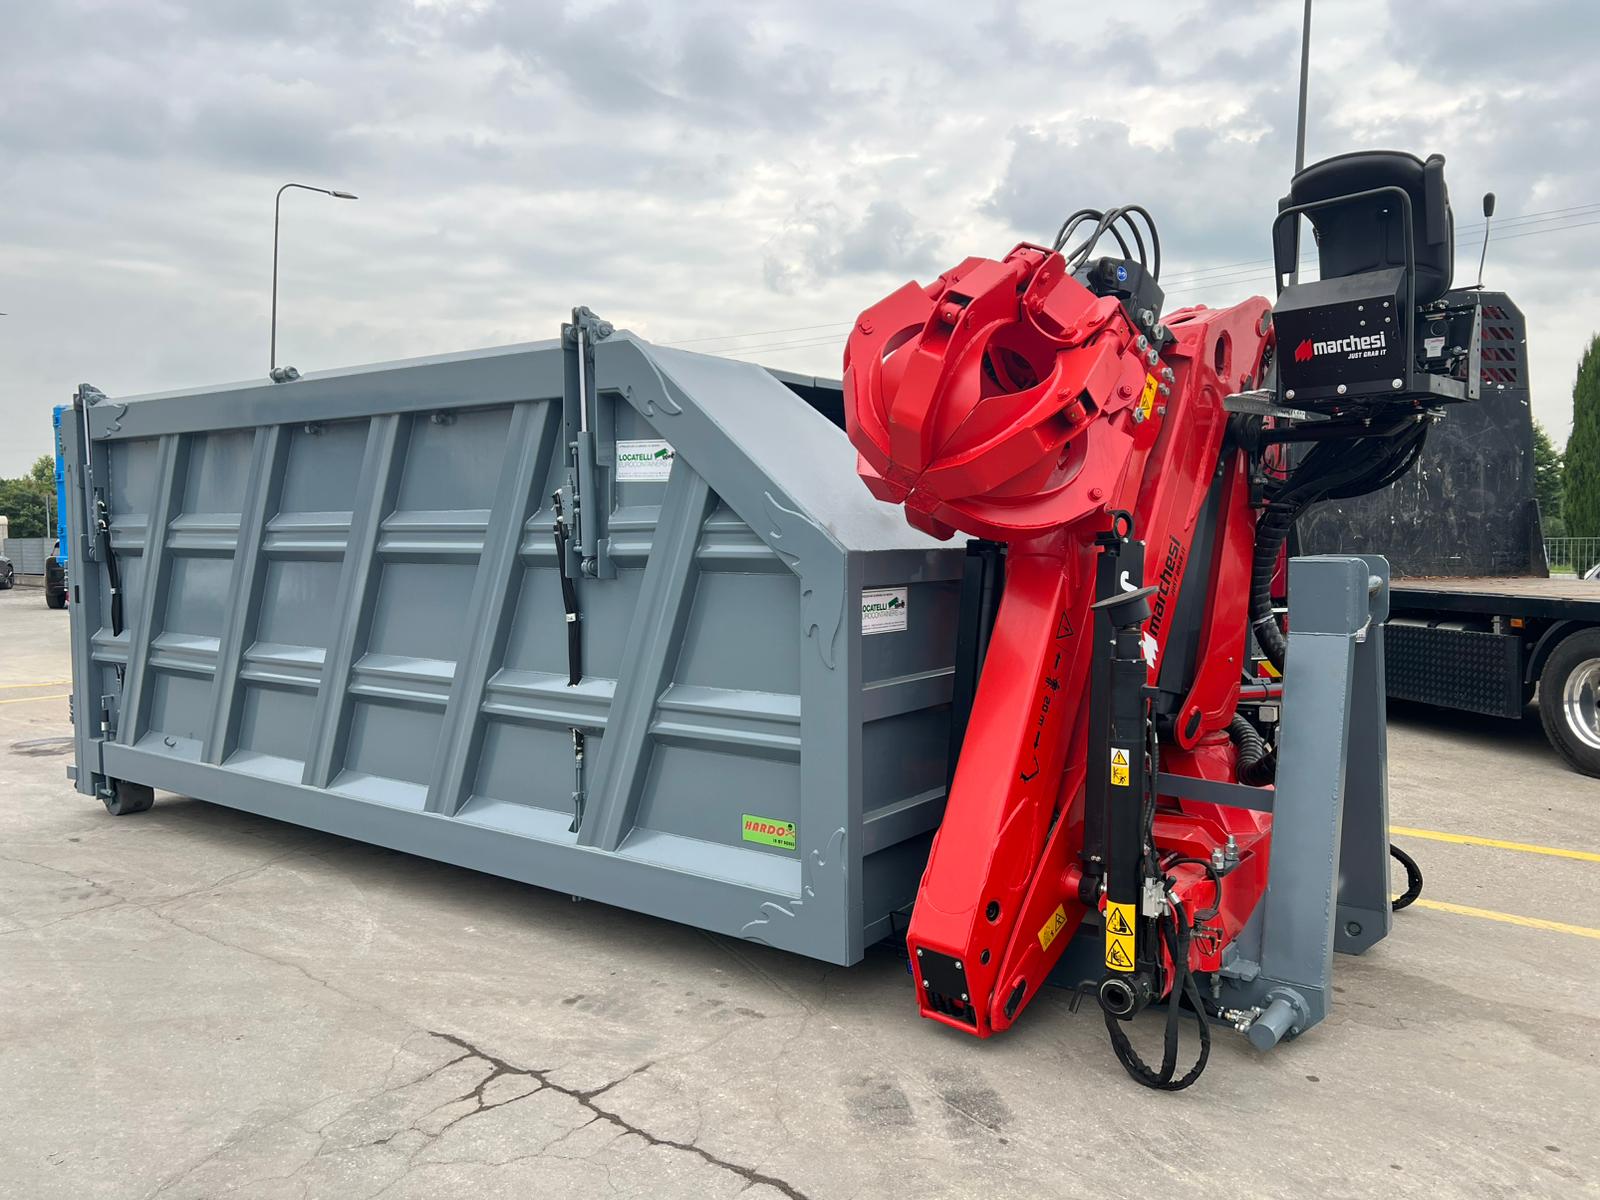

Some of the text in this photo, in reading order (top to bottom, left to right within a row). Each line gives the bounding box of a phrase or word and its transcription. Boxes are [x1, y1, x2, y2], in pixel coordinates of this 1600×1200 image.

[1313, 331, 1386, 356] marchesi
[1347, 352, 1362, 360] JUST
[1149, 535, 1181, 637] marchesi
[862, 603, 887, 612] OCATELLI
[1042, 695, 1051, 713] 20
